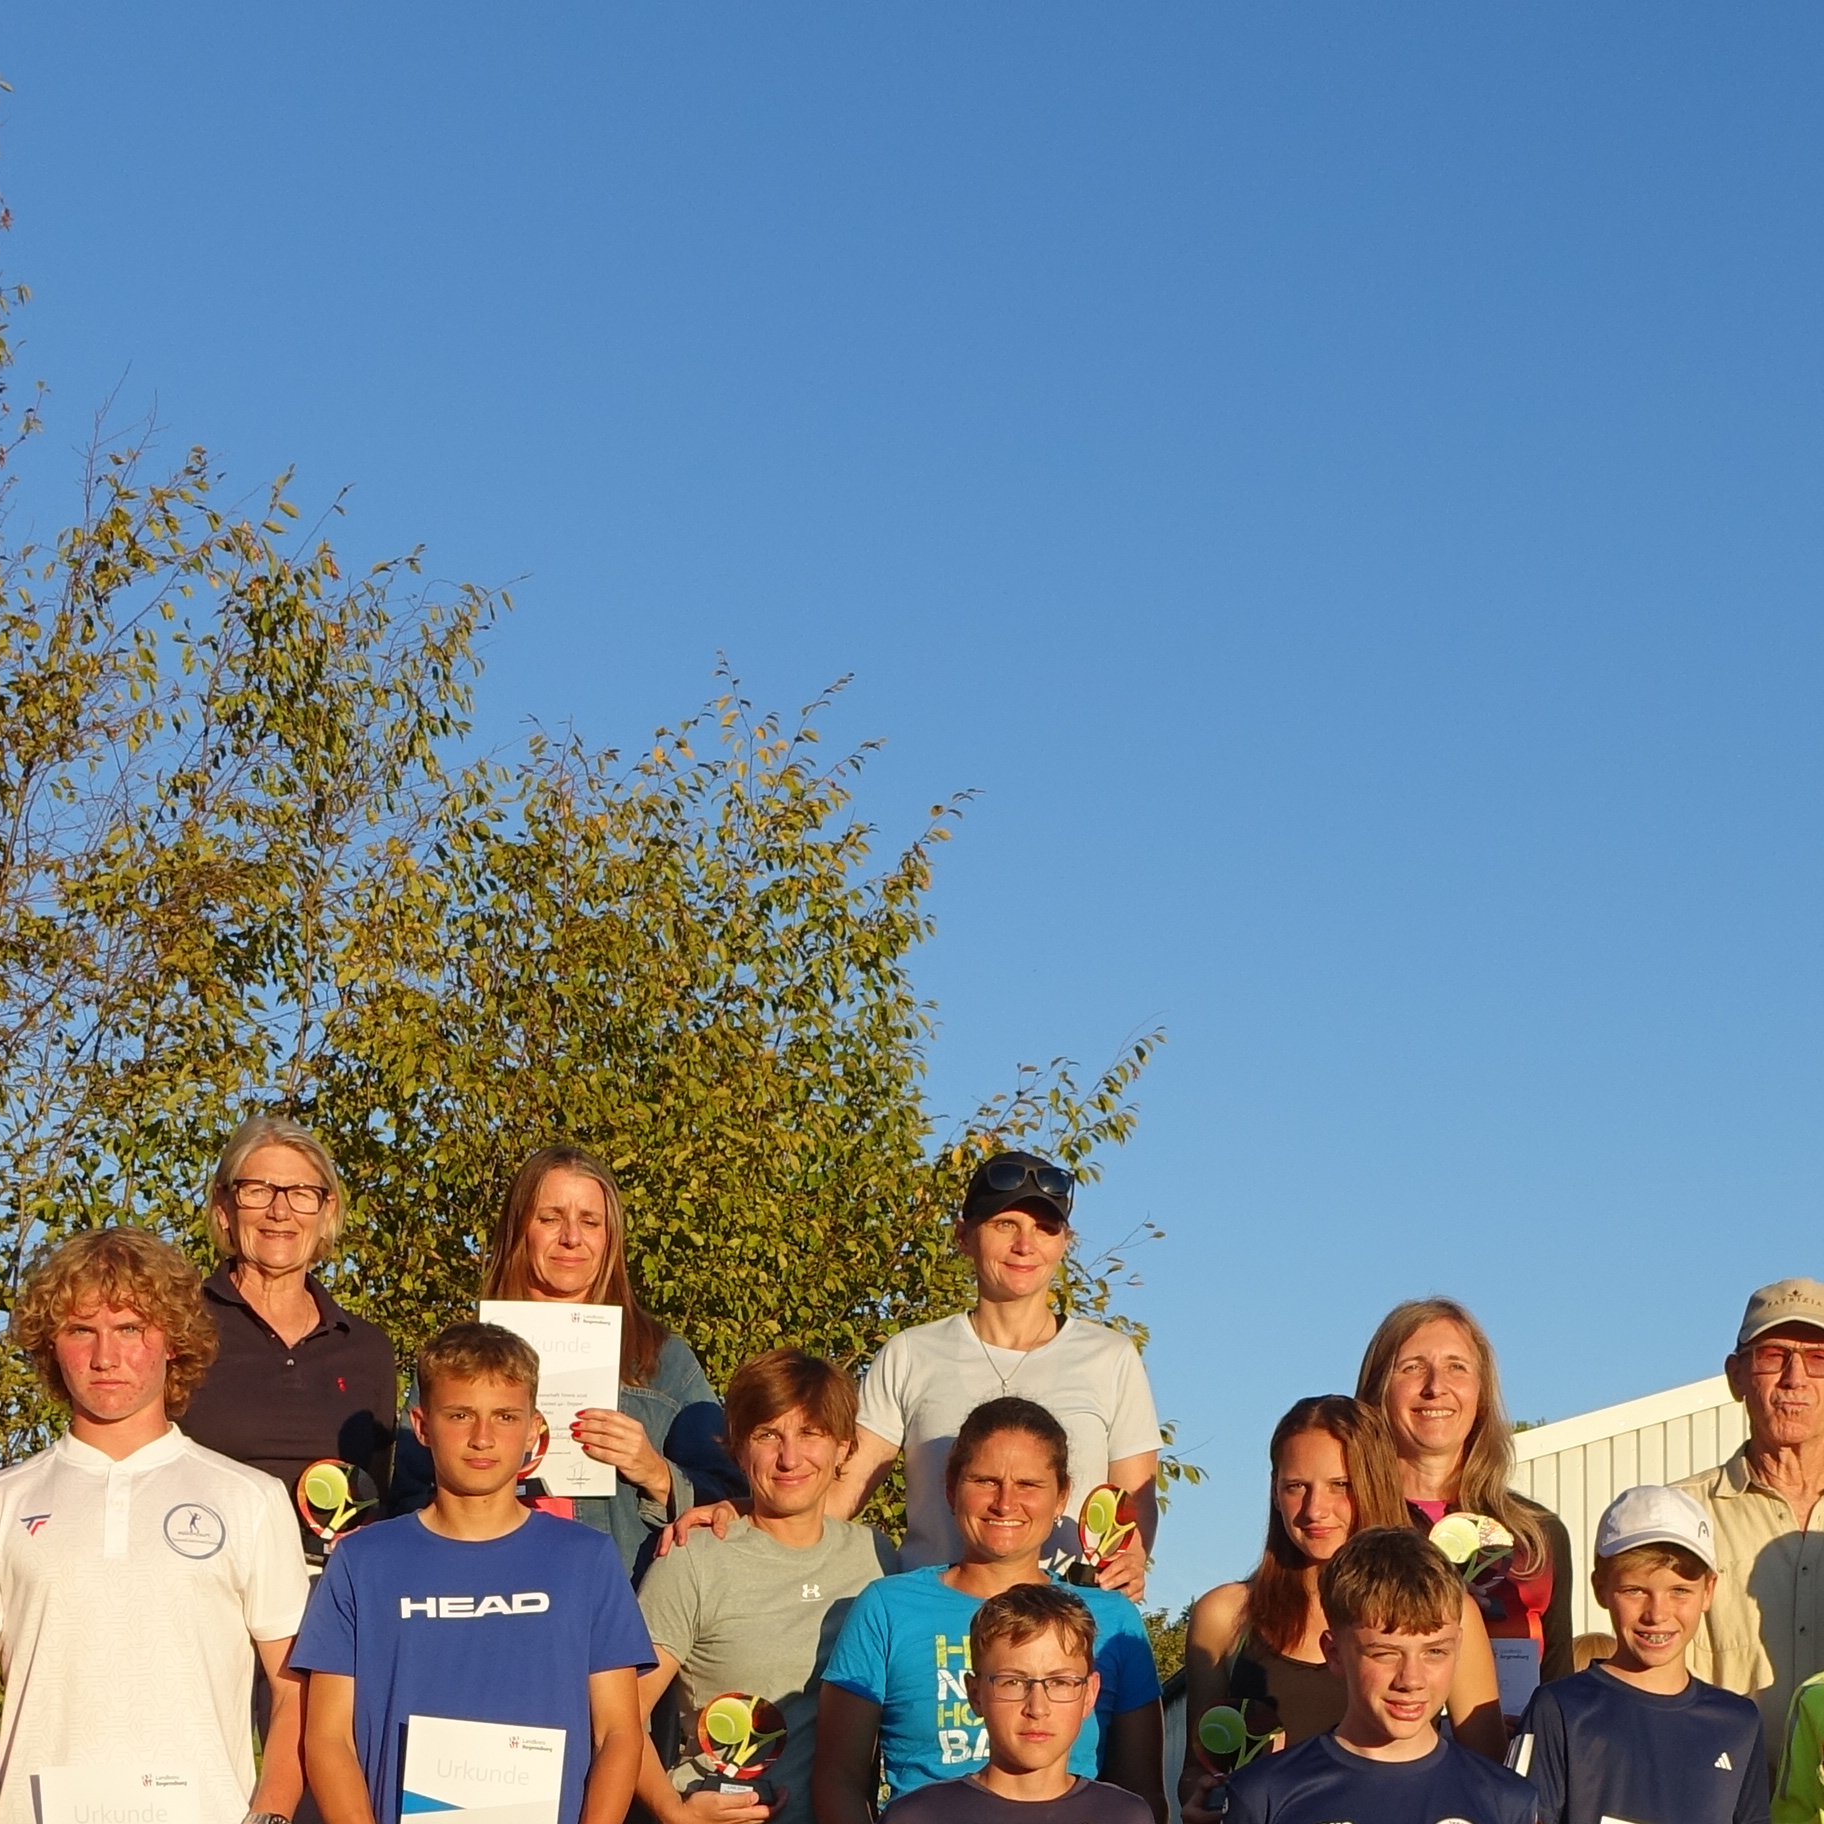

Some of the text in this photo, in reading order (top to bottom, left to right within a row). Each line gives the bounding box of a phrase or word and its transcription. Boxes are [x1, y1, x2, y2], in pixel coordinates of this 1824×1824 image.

[1767, 1297, 1822, 1308] PATRIZIA
[532, 1335, 591, 1354] kunde
[401, 1592, 550, 1619] HEAD
[522, 1744, 553, 1754] Regensburg
[437, 1758, 529, 1786] Urkunde
[156, 1780, 188, 1788] Regensburg
[74, 1805, 168, 1824] Urkunde
